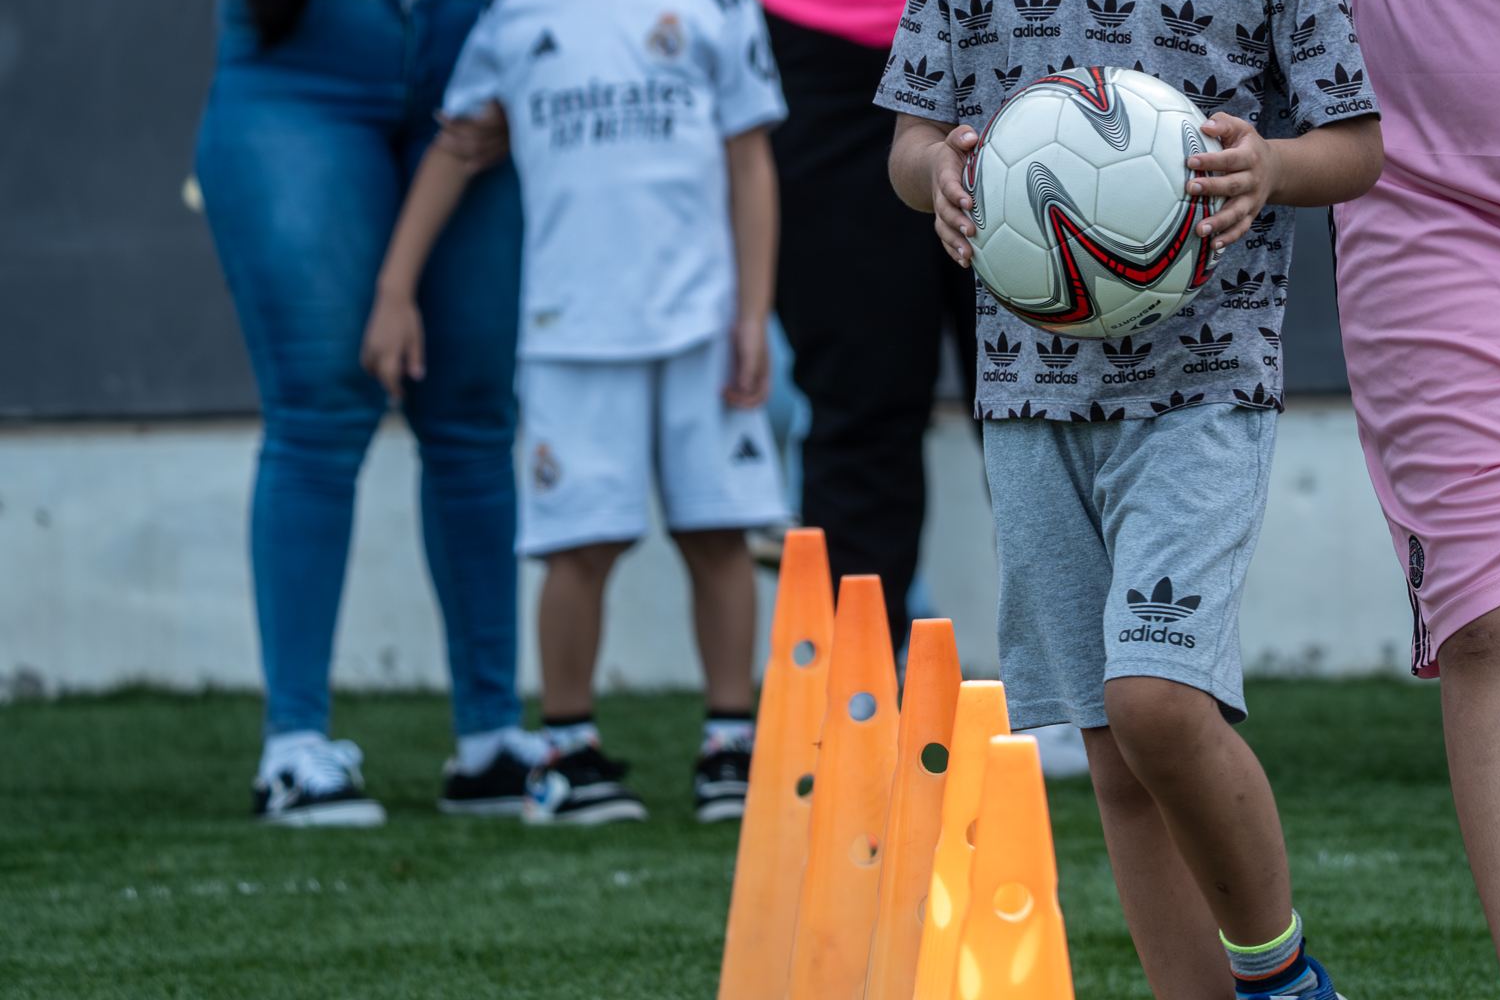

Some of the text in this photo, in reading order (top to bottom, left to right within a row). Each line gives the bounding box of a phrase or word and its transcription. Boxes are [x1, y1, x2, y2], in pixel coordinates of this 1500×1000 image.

[958, 28, 998, 49] adidas
[1013, 23, 1061, 38] adidas
[1085, 28, 1132, 44] adidas
[1154, 35, 1207, 55] adidas
[1227, 52, 1269, 70] adidas
[895, 90, 937, 111] adidas
[1325, 97, 1373, 115] adidas
[1221, 296, 1269, 310] adidas
[1182, 356, 1239, 374] adidas
[983, 369, 1019, 383] adidas
[1035, 371, 1078, 385] adidas
[1101, 366, 1156, 385] adidas
[1119, 624, 1196, 649] adidas
